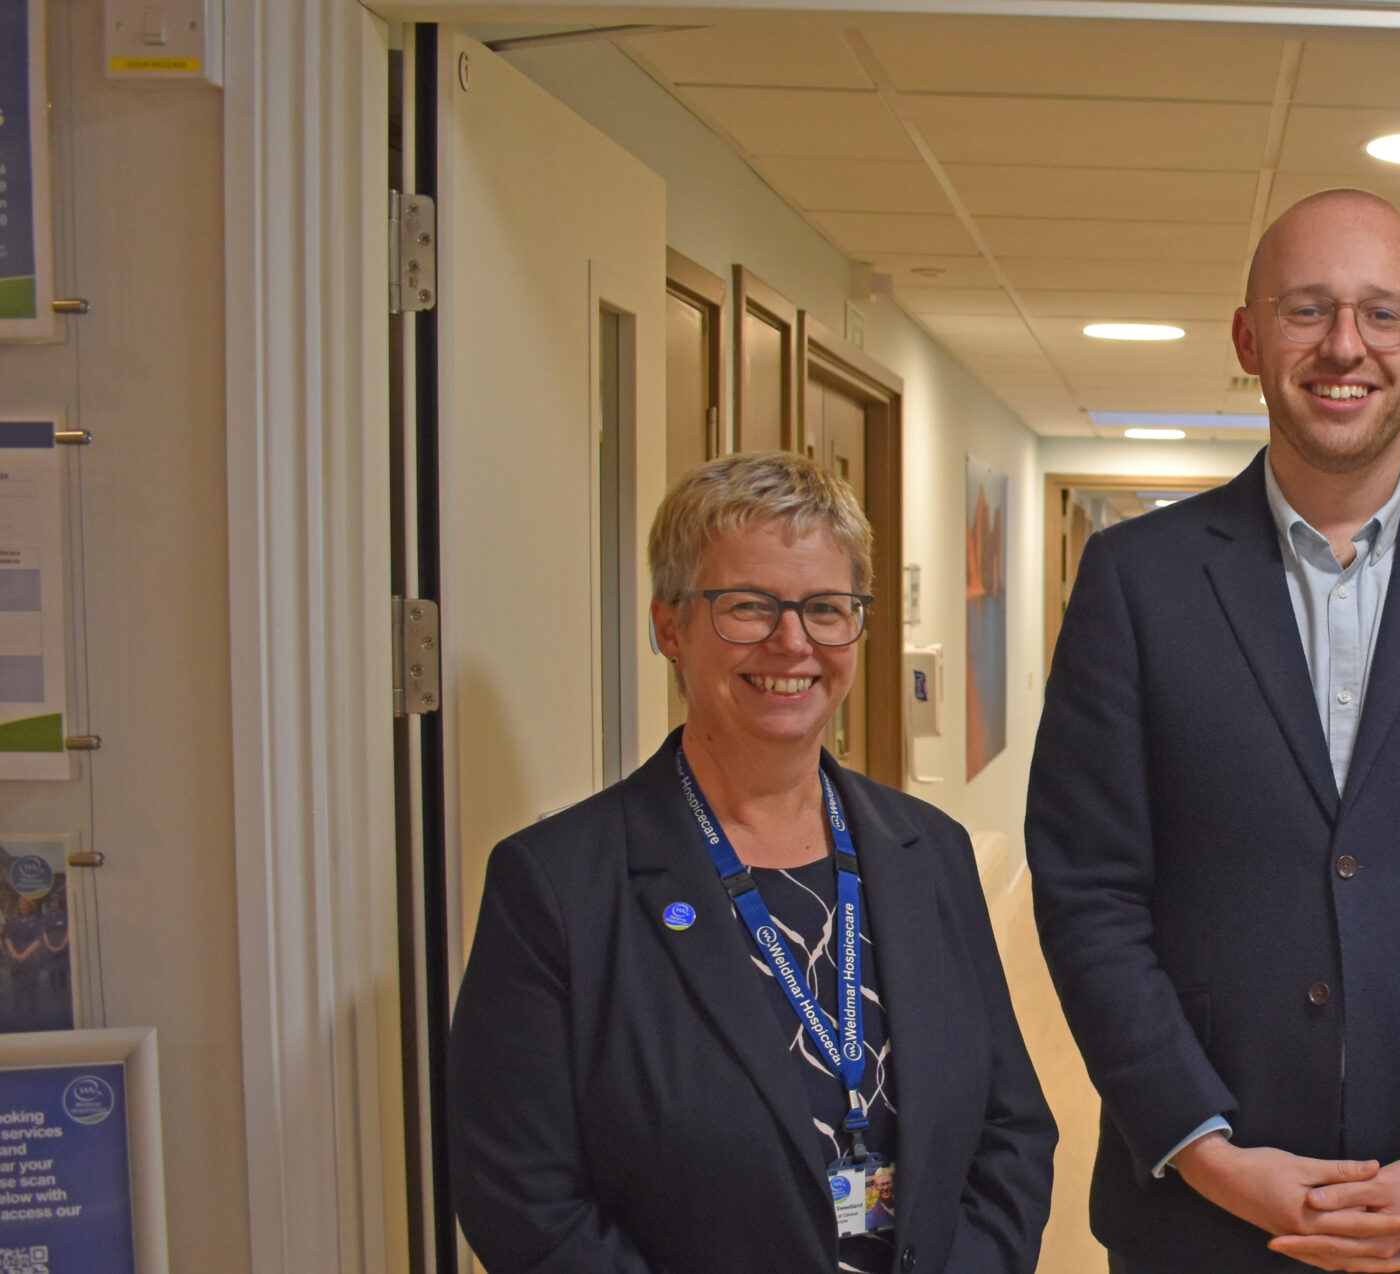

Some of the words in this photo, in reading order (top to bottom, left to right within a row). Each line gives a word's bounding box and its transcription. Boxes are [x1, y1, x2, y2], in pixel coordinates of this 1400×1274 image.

[680, 776, 720, 845] Hospicecare
[843, 902, 855, 981] Hospicecare
[767, 942, 805, 999] Weldmar
[800, 999, 842, 1067] Hospiceca
[844, 983, 857, 1042] Weldmar
[1, 1126, 63, 1140] services
[0, 1142, 28, 1156] and
[19, 1159, 54, 1174] your
[20, 1176, 56, 1187] scan
[35, 1188, 67, 1202] with
[1, 1208, 53, 1220] access
[56, 1205, 82, 1217] our
